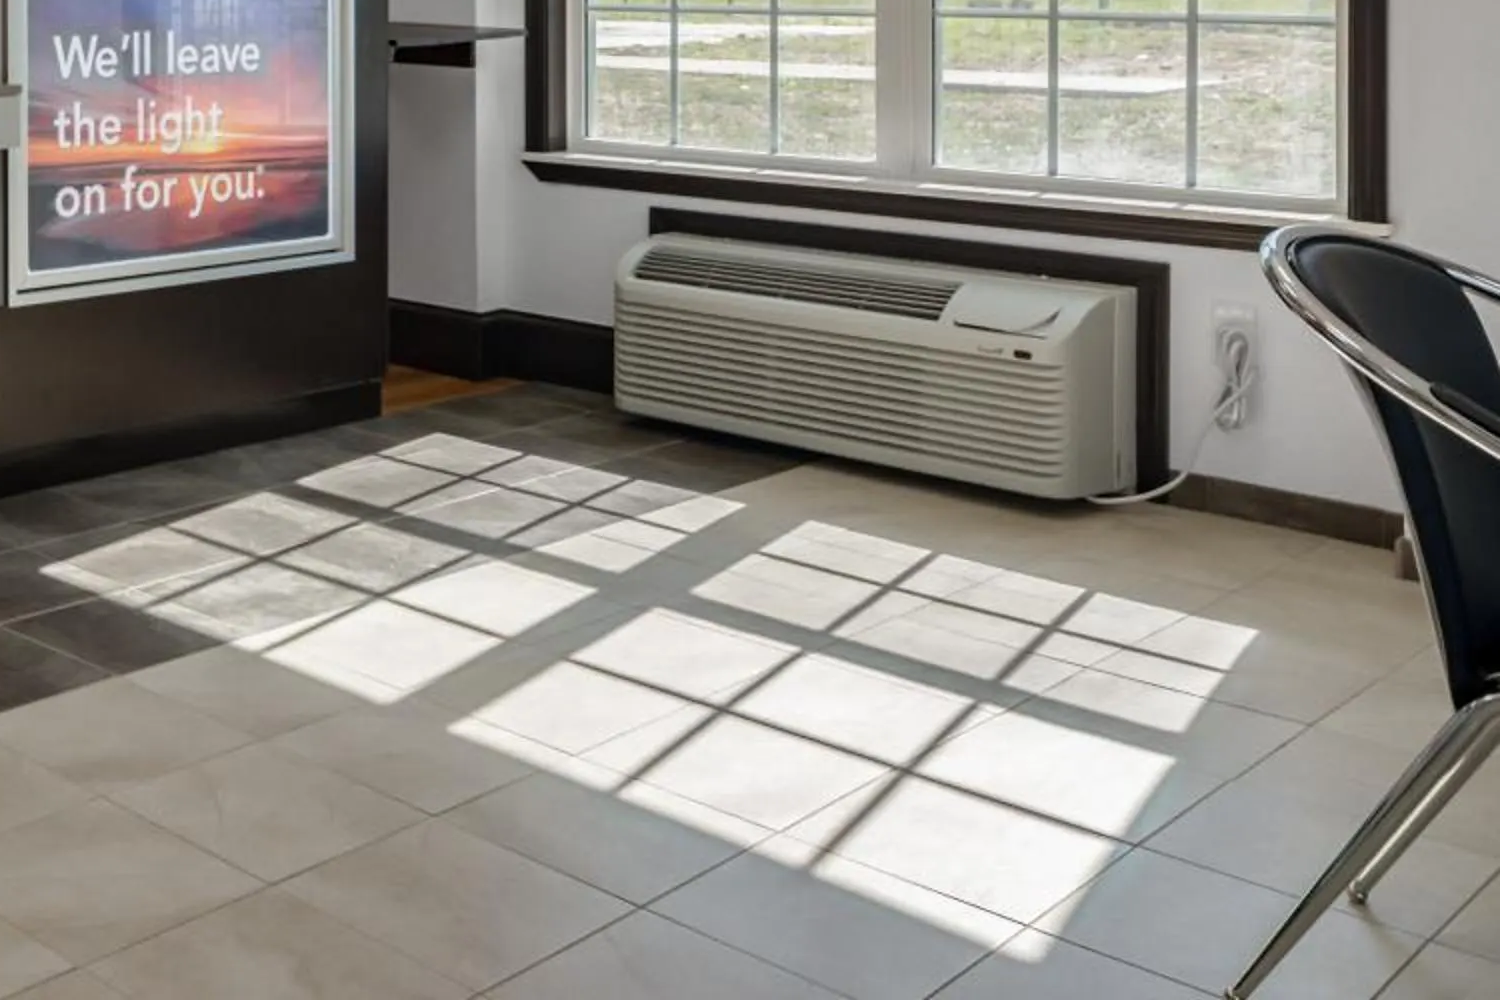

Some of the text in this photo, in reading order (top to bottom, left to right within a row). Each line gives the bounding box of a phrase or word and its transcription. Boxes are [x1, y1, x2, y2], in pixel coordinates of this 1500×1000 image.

[53, 29, 261, 79] We'll leave
[53, 95, 224, 155] the light
[55, 182, 106, 218] on
[120, 165, 178, 212] for
